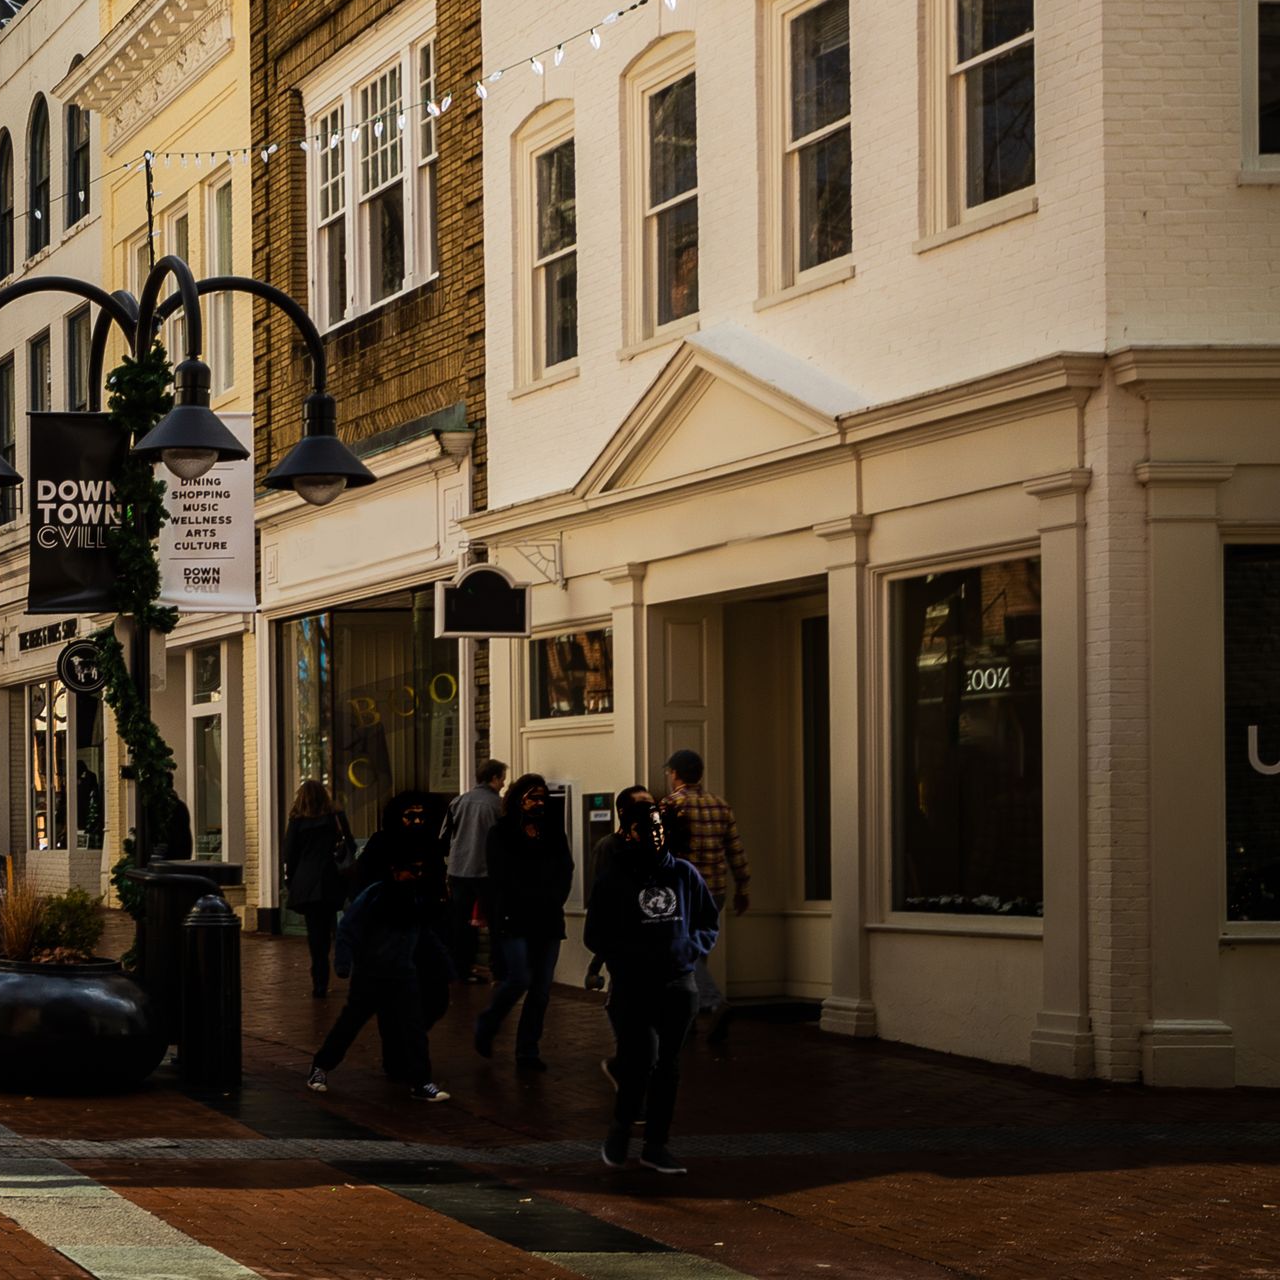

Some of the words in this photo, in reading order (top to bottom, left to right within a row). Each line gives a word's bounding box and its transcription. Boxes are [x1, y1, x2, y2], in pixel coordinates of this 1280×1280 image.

[181, 478, 221, 486] DINING
[171, 491, 231, 499] SHOPPING
[183, 504, 219, 512] MUSIC
[37, 503, 122, 525] TOWN
[170, 516, 232, 525] WELLNESS
[37, 525, 122, 549] CVILL
[185, 529, 216, 538] ARTS
[174, 541, 228, 551] CULTURE
[183, 567, 221, 576] DOWN
[183, 576, 221, 585] TOWN
[183, 584, 221, 594] CVILLE
